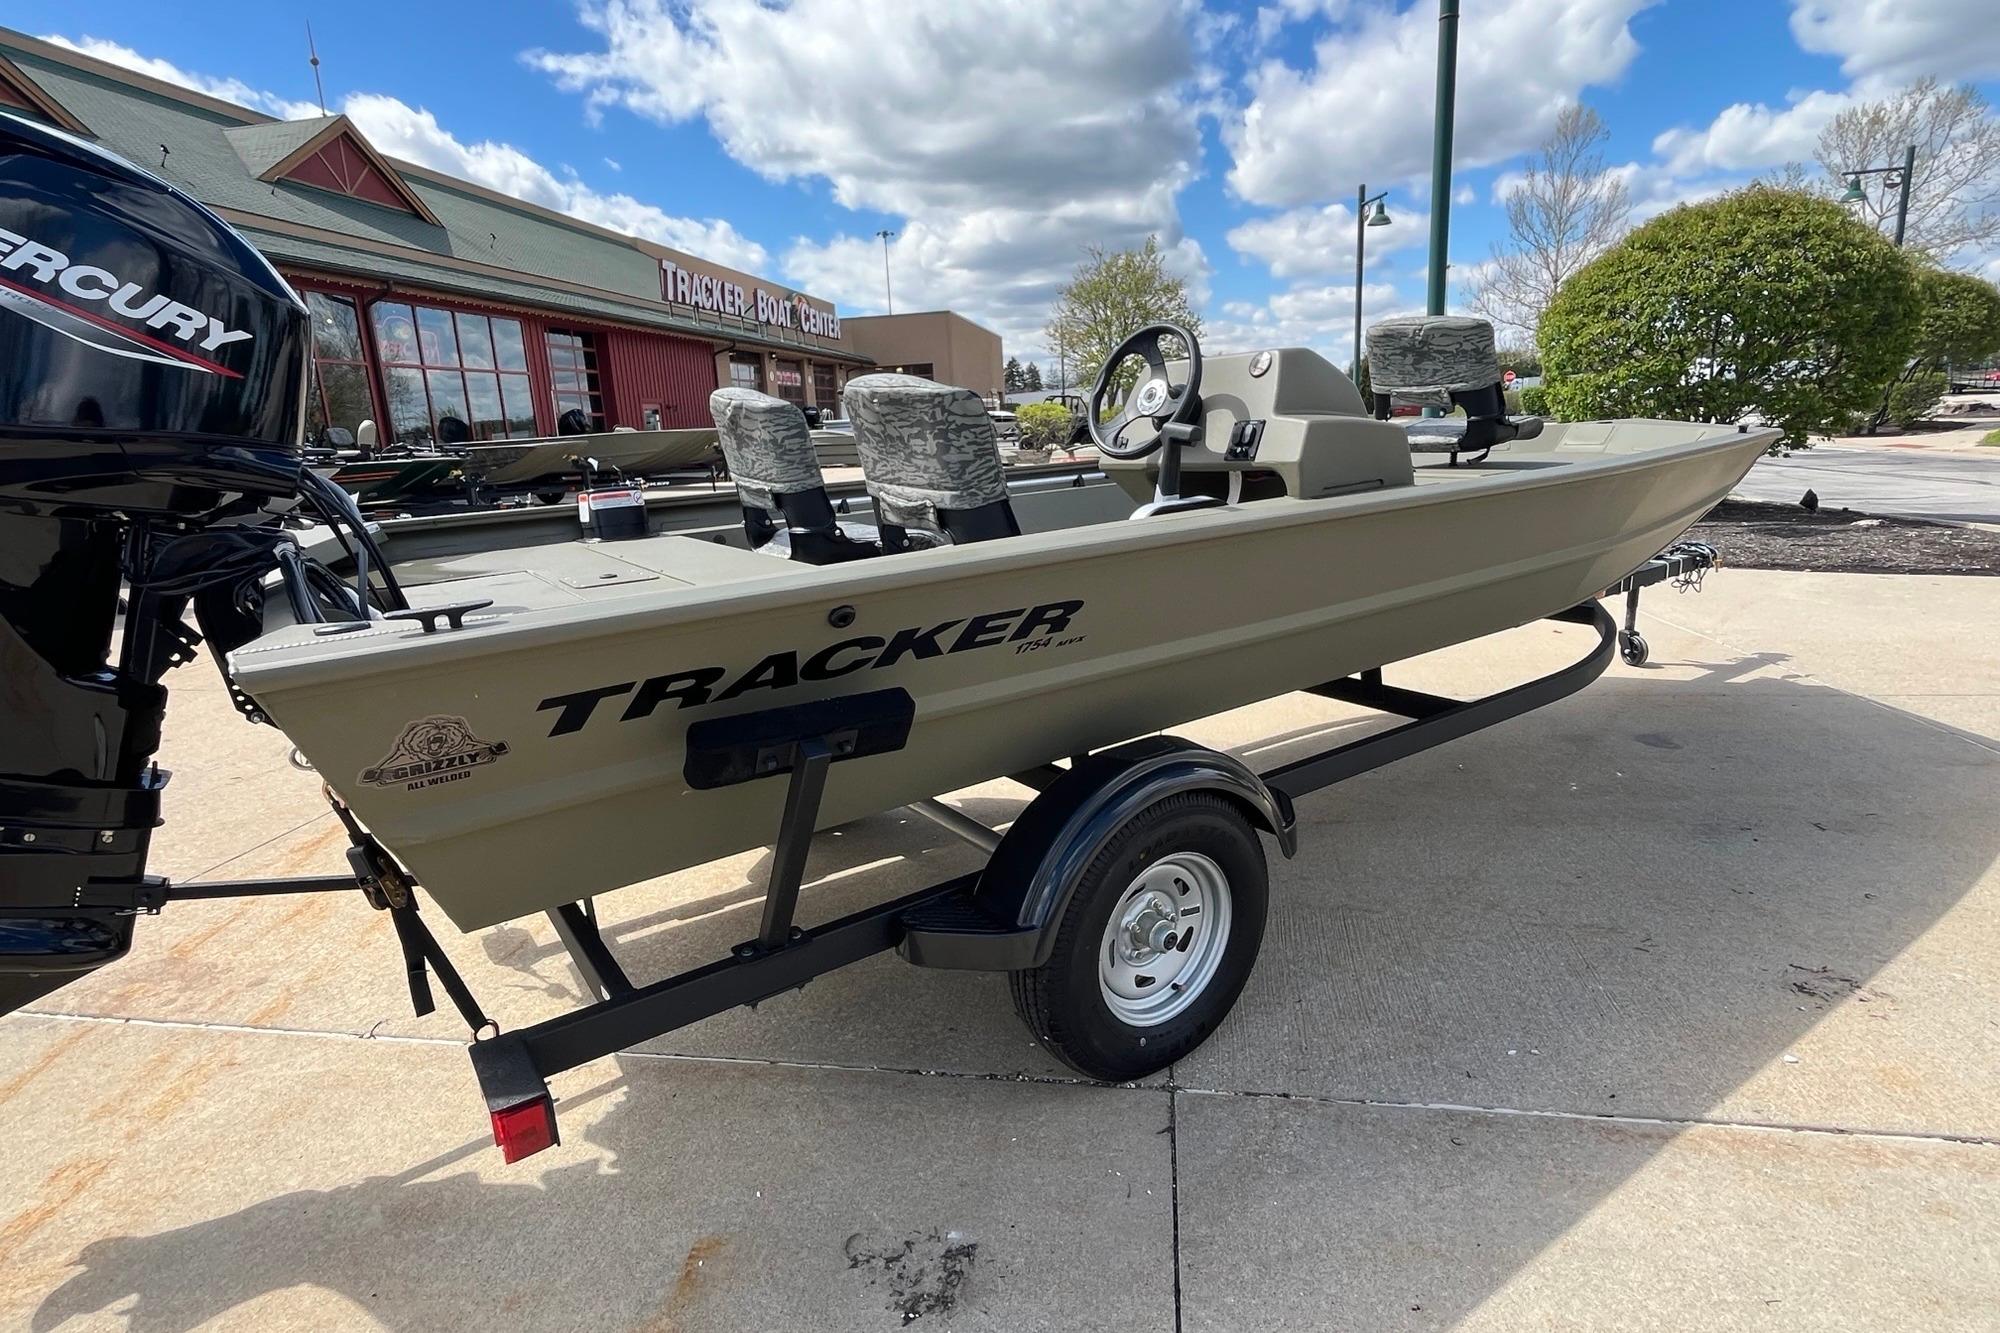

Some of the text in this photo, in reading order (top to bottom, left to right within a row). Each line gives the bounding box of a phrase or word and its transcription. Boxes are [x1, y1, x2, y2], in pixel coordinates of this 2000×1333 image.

[660, 258, 841, 340] TRACKER BOAT CENTER
[1015, 636, 1054, 655] 1754
[536, 599, 1085, 738] TRACKER
[393, 751, 480, 780] GRIZZLY
[407, 770, 471, 791] ALL WELDED
